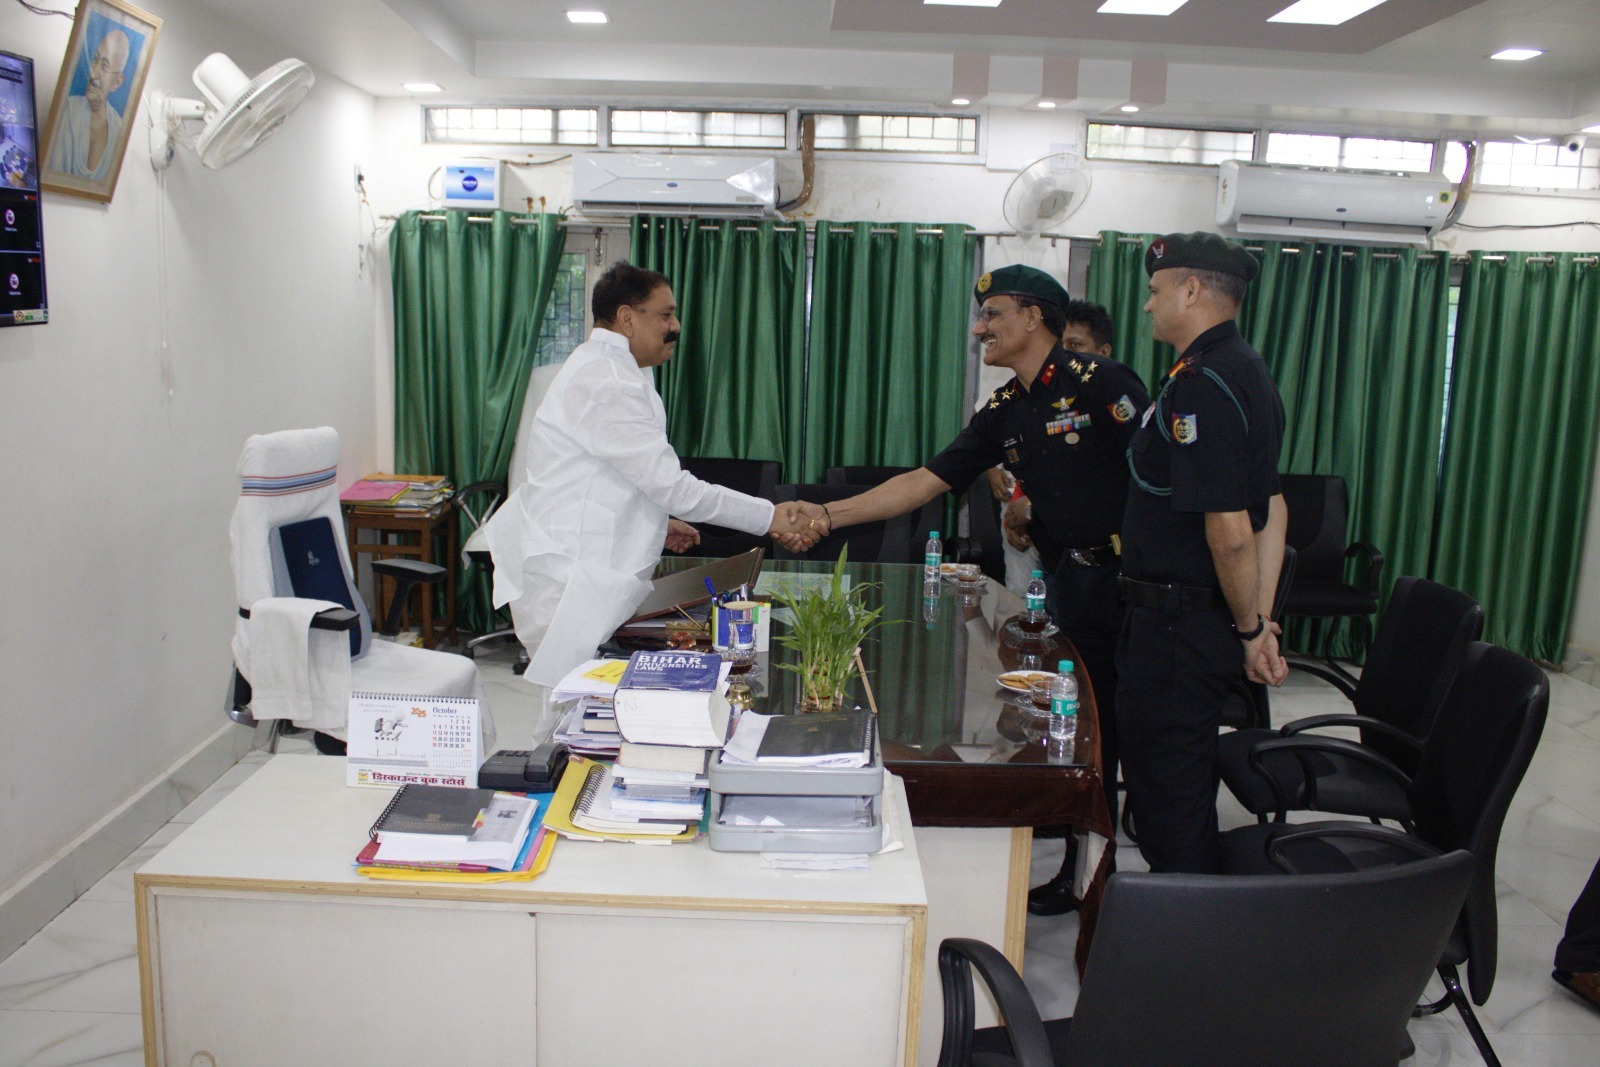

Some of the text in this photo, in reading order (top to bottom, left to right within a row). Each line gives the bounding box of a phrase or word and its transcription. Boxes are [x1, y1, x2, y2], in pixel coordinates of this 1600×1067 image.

[638, 656, 701, 664] BIHAR
[411, 708, 426, 718] 2025
[421, 776, 438, 786] बुक
[442, 776, 466, 785] स्टोर्स
